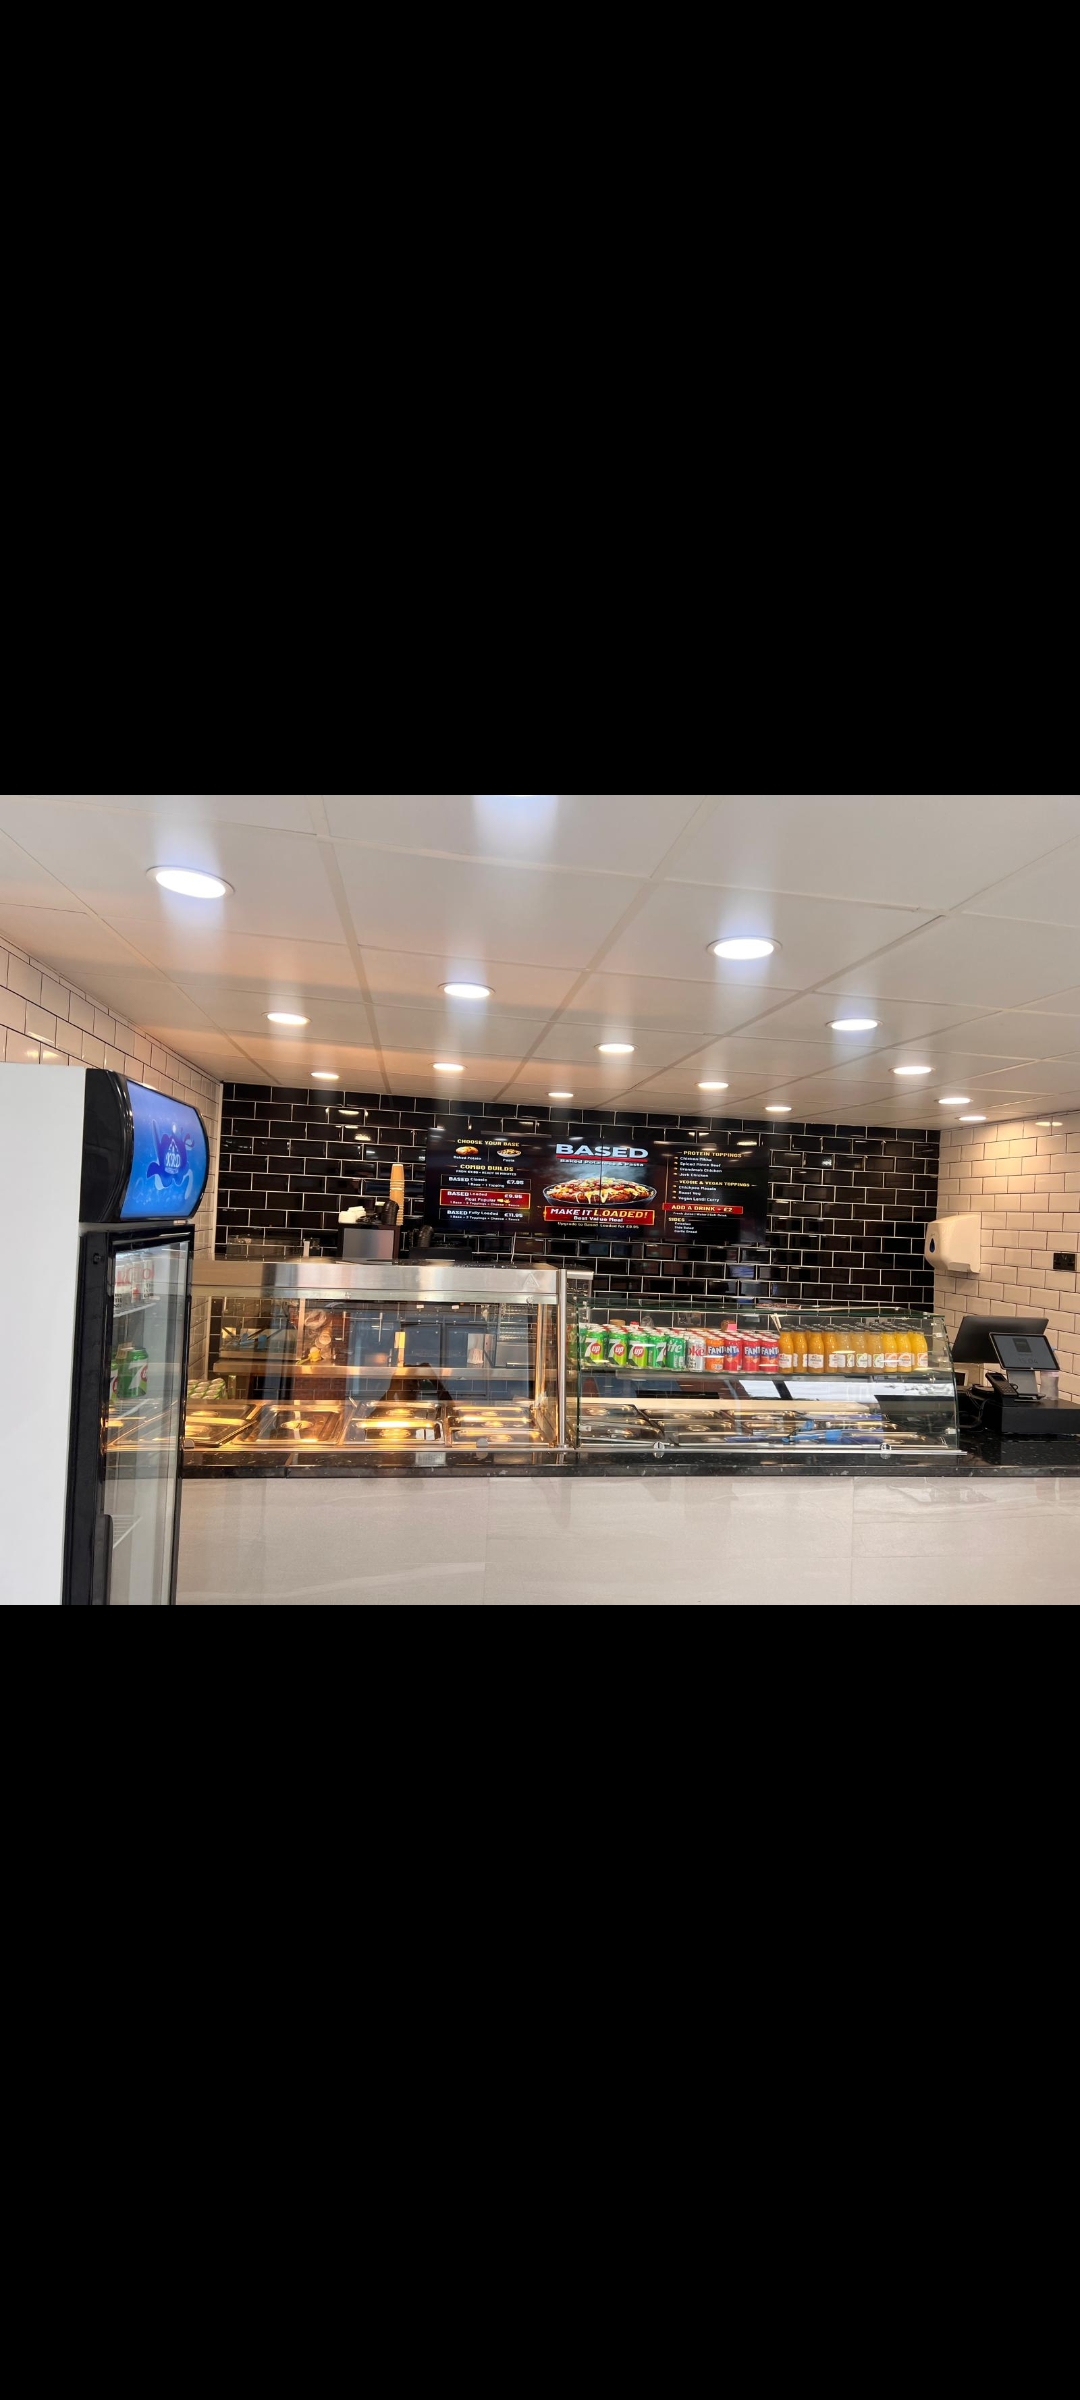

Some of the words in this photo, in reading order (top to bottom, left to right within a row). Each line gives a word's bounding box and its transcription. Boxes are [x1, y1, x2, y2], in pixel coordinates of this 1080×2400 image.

[556, 1144, 648, 1158] BASED
[594, 1210, 648, 1218] LOADED!
[708, 1346, 724, 1354] FANT
